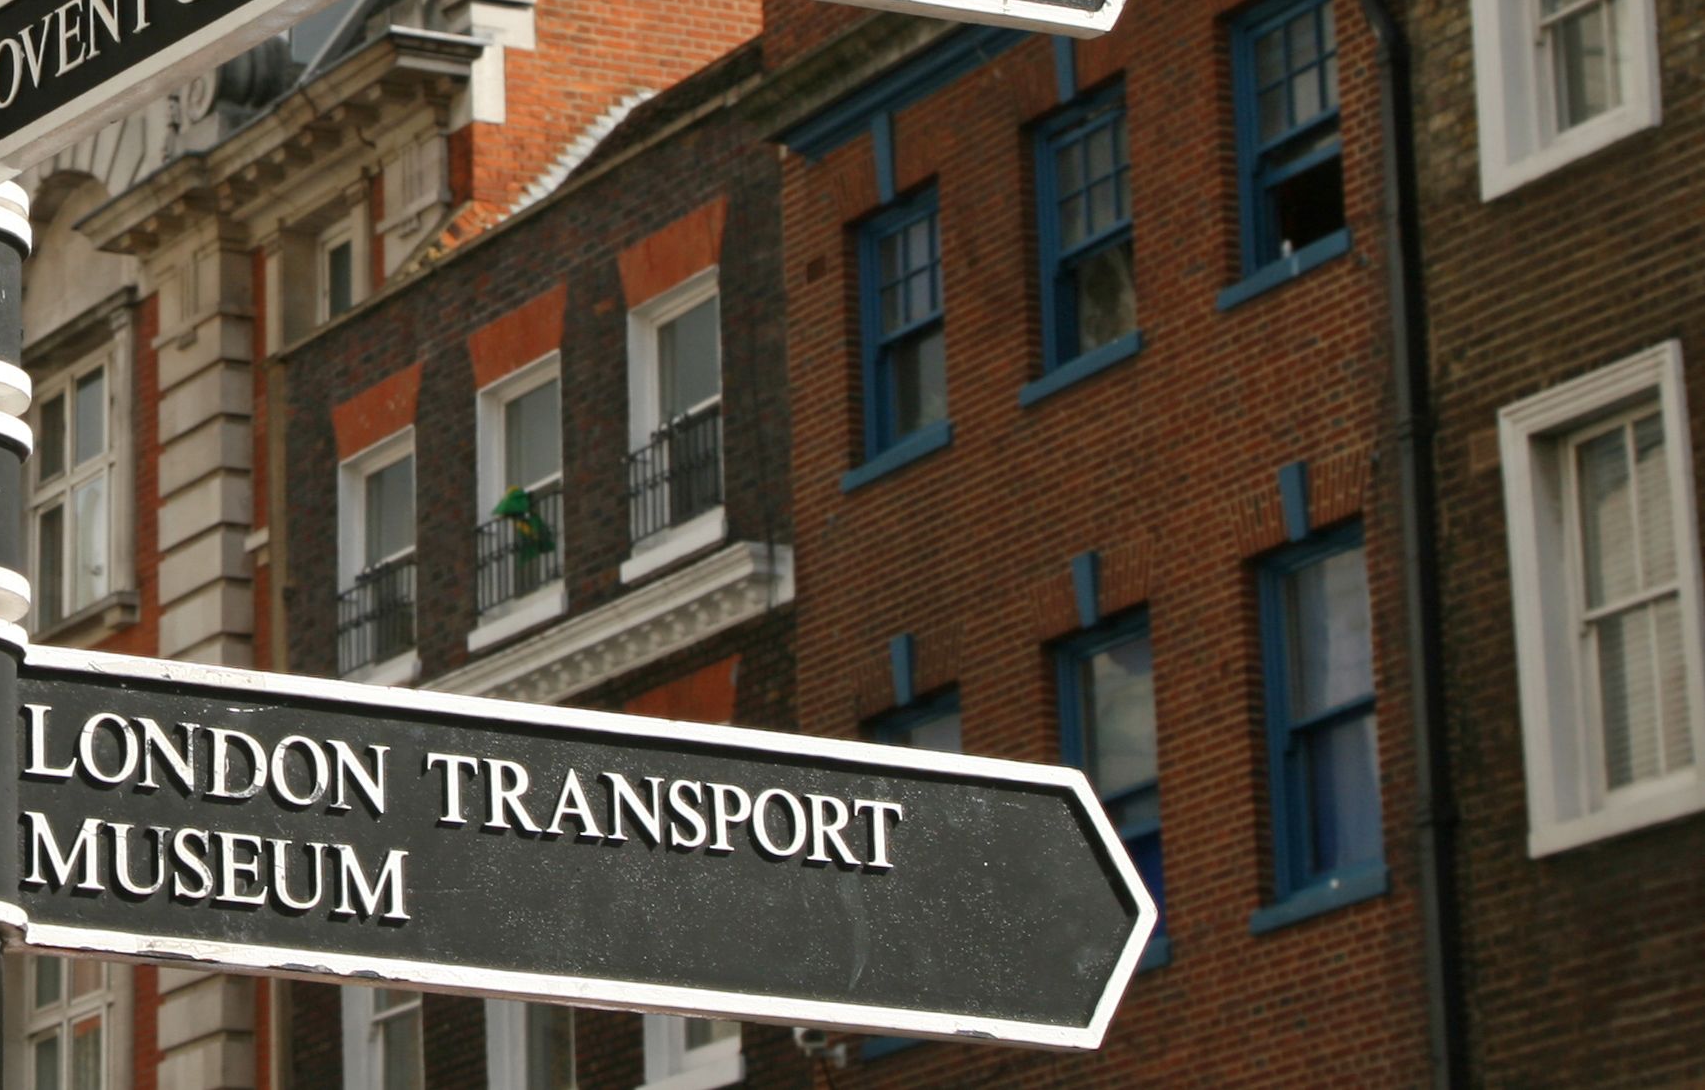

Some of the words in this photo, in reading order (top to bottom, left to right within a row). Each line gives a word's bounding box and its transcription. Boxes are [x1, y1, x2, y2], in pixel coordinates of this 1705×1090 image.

[22, 703, 391, 816] LONDON
[426, 751, 903, 871] TRANSPORT
[24, 811, 411, 921] MUSEUM
